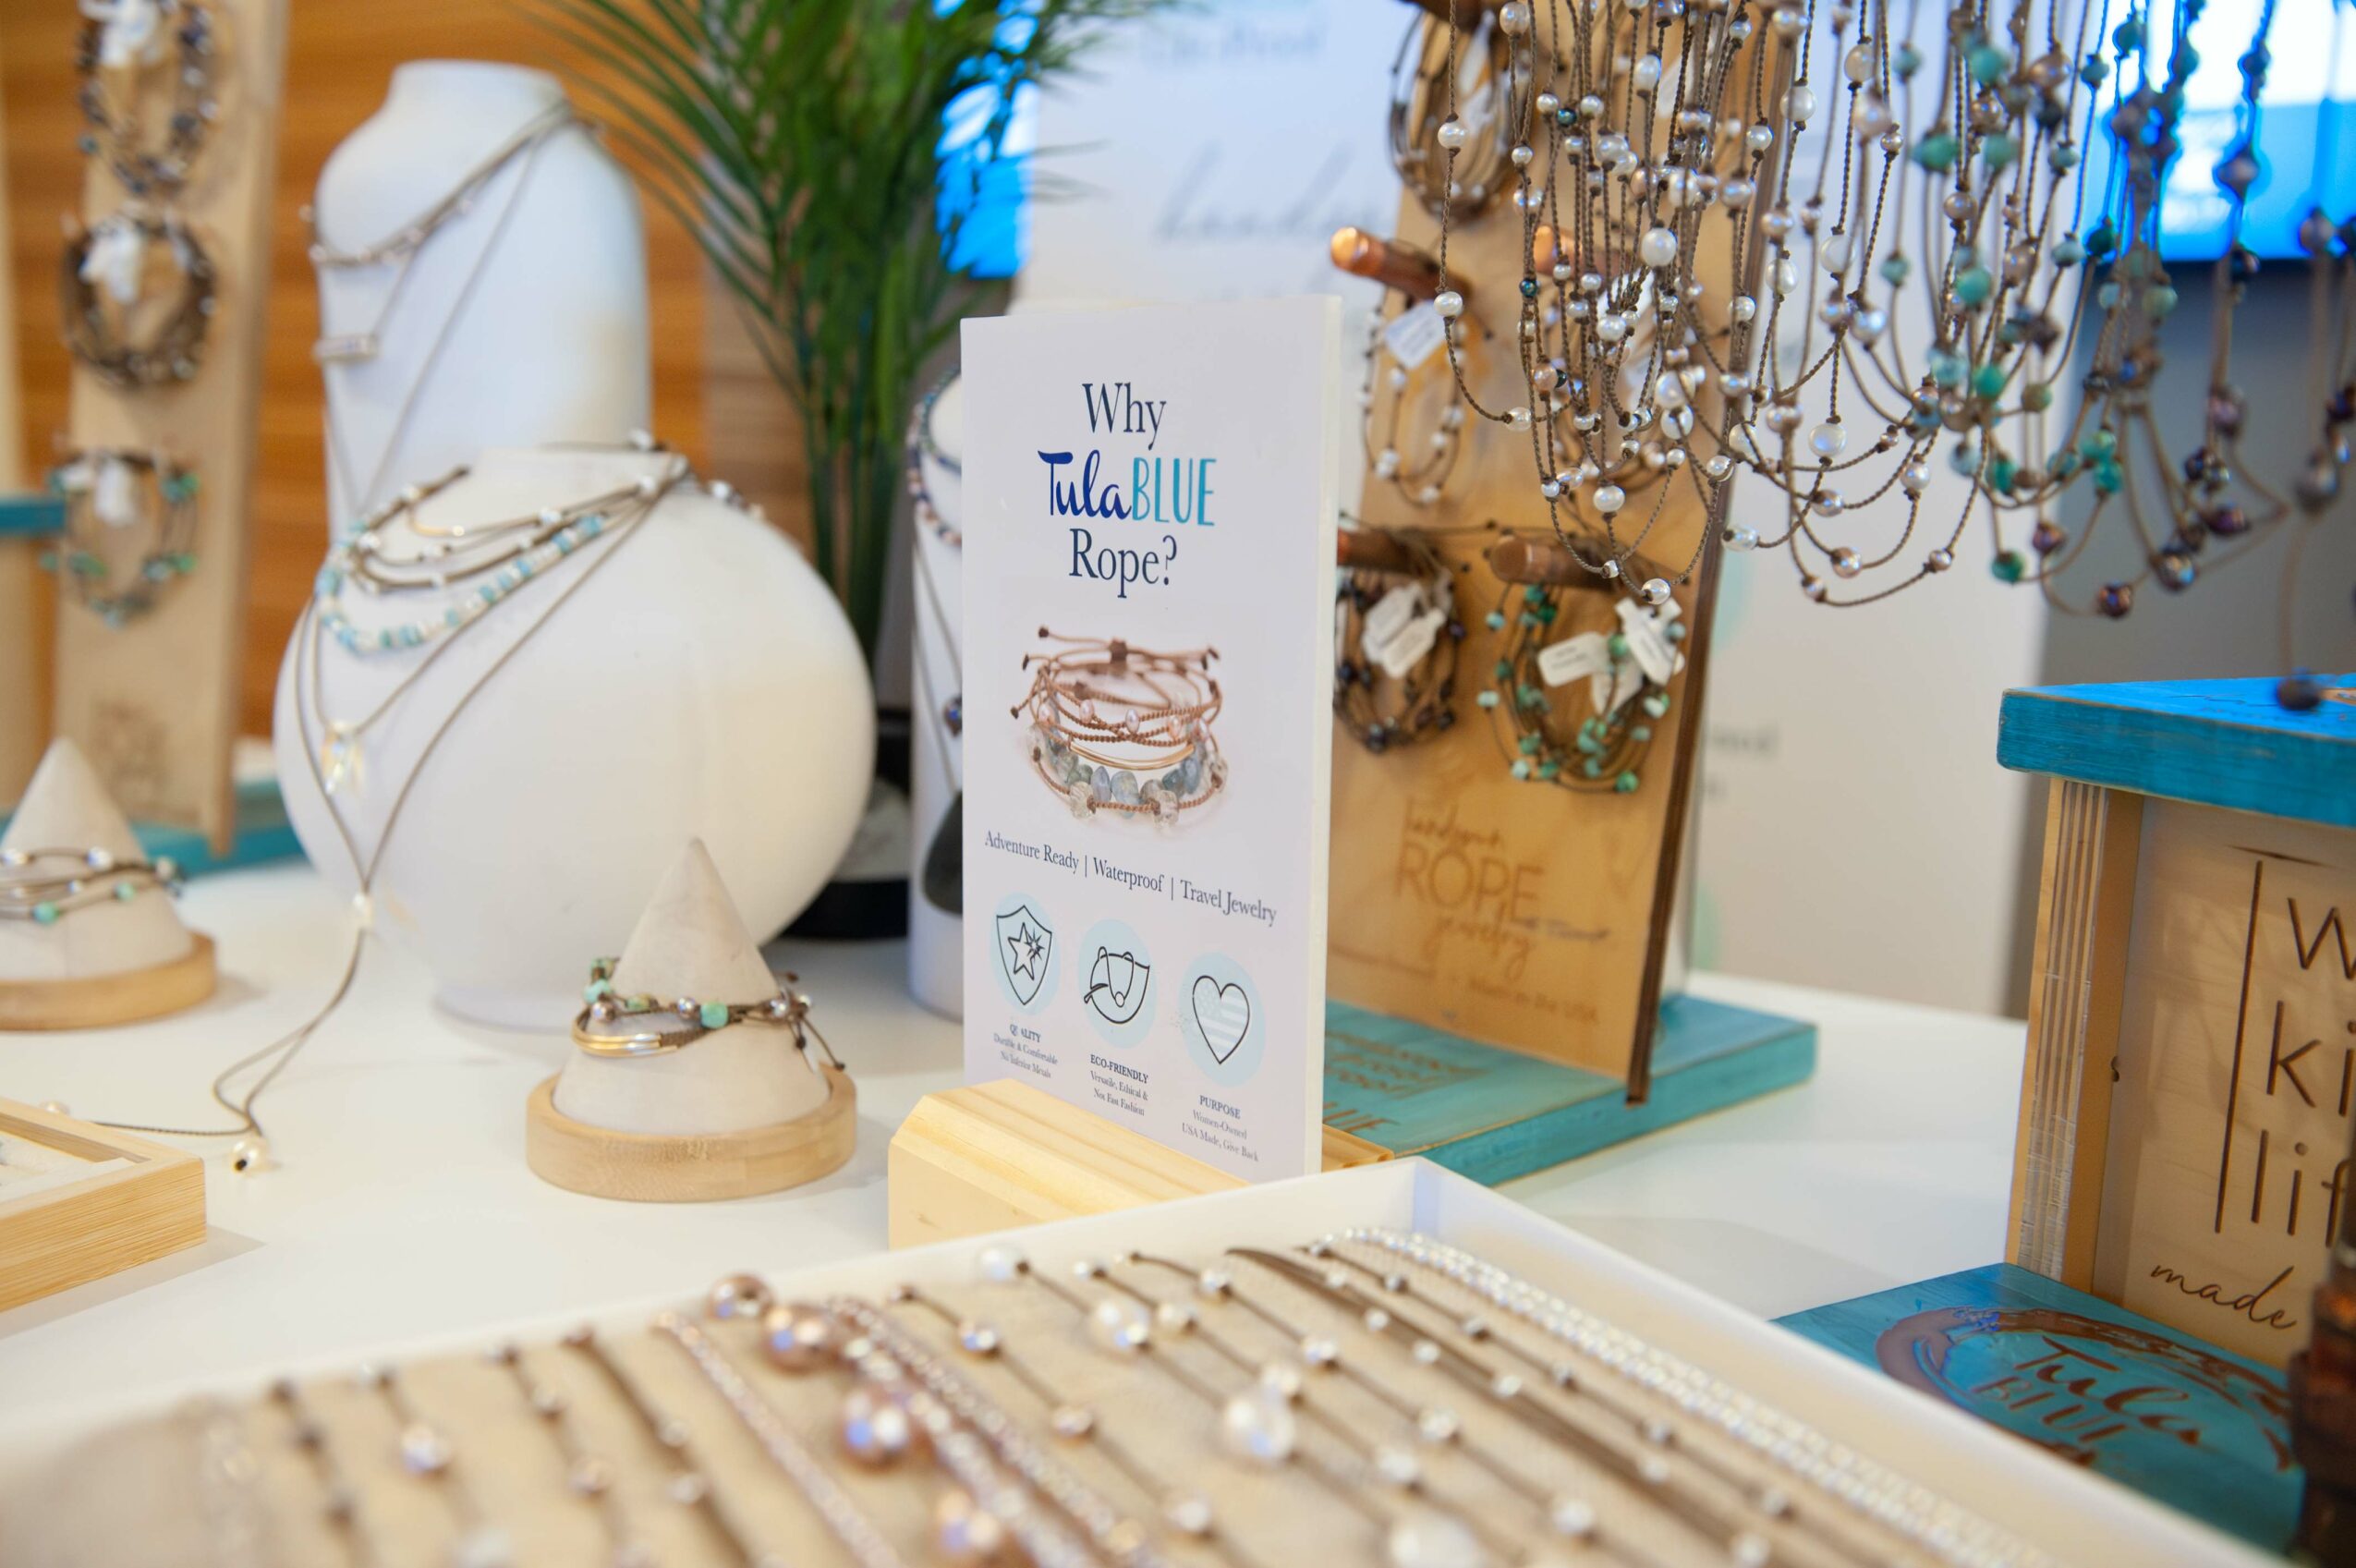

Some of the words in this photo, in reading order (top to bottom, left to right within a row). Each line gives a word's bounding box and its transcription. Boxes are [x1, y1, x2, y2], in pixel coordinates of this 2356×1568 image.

[1082, 382, 1167, 451] Why
[1038, 449, 1217, 526] TulaBLUE
[1069, 528, 1178, 599] Rope?
[985, 830, 1040, 859] Adventure
[1043, 844, 1079, 874] Ready
[1093, 857, 1165, 892] Waterproof
[1180, 879, 1222, 908] Travel
[1222, 892, 1277, 928] Jewelry
[1394, 841, 1545, 924] ROPE
[1090, 1053, 1148, 1084] ECO-FRIENDLY
[1119, 1081, 1141, 1098] Ethical
[1121, 1098, 1145, 1116] Fashion
[1182, 1122, 1198, 1138] USA
[1193, 1109, 1247, 1140] Women-Owned
[1199, 1095, 1241, 1120] PURPOSE
[2151, 1264, 2298, 1331] made
[2012, 1334, 2203, 1448] Tula
